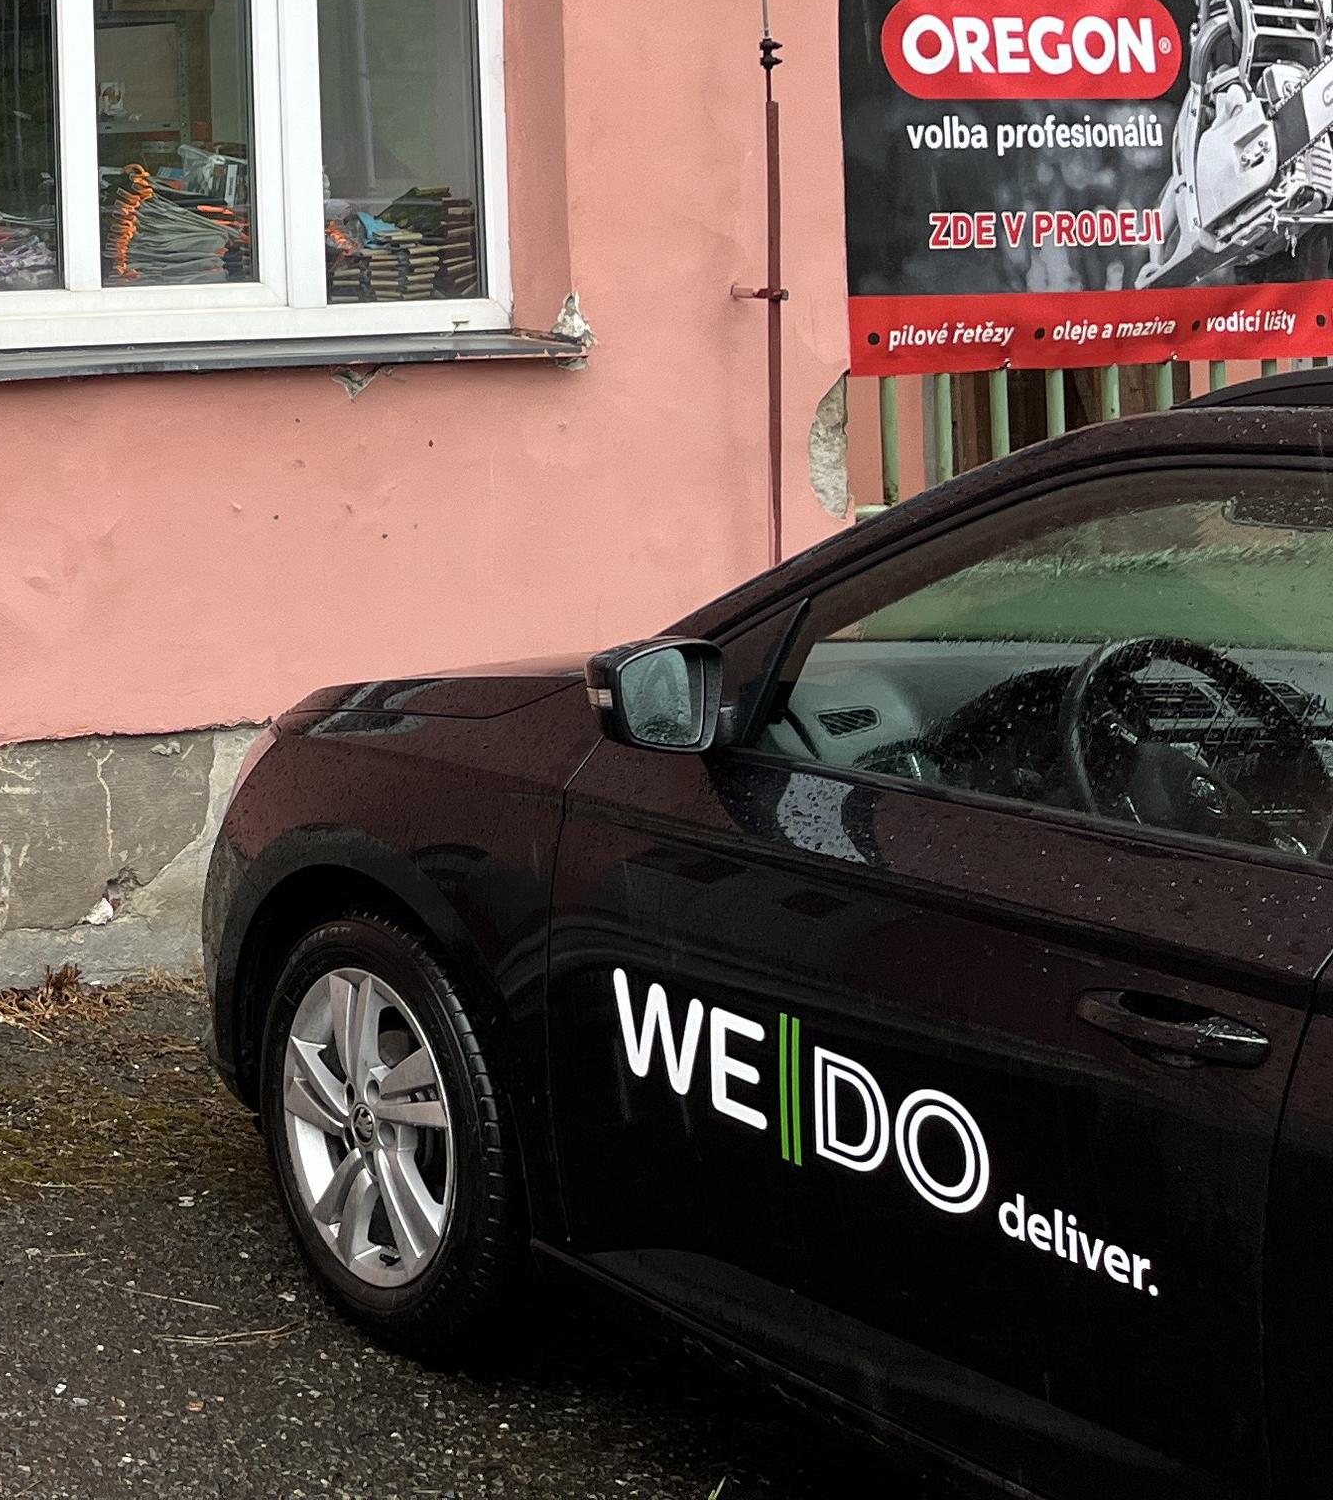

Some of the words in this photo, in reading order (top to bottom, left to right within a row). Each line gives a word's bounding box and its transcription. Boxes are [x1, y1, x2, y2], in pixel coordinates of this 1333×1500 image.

[906, 115, 989, 149] volba
[996, 114, 1164, 156] profesionálů
[929, 211, 997, 249] ZDE
[1001, 211, 1027, 247] V
[1032, 209, 1165, 247] PRODEJI
[888, 322, 949, 351] pilové
[952, 320, 1015, 347] řetězy
[1052, 319, 1098, 345] oleje
[1101, 322, 1113, 339] a
[1116, 316, 1176, 339] maziva
[1206, 309, 1262, 332] vodící
[1263, 308, 1297, 335] lišty
[998, 1193, 1159, 1297] deliver.
